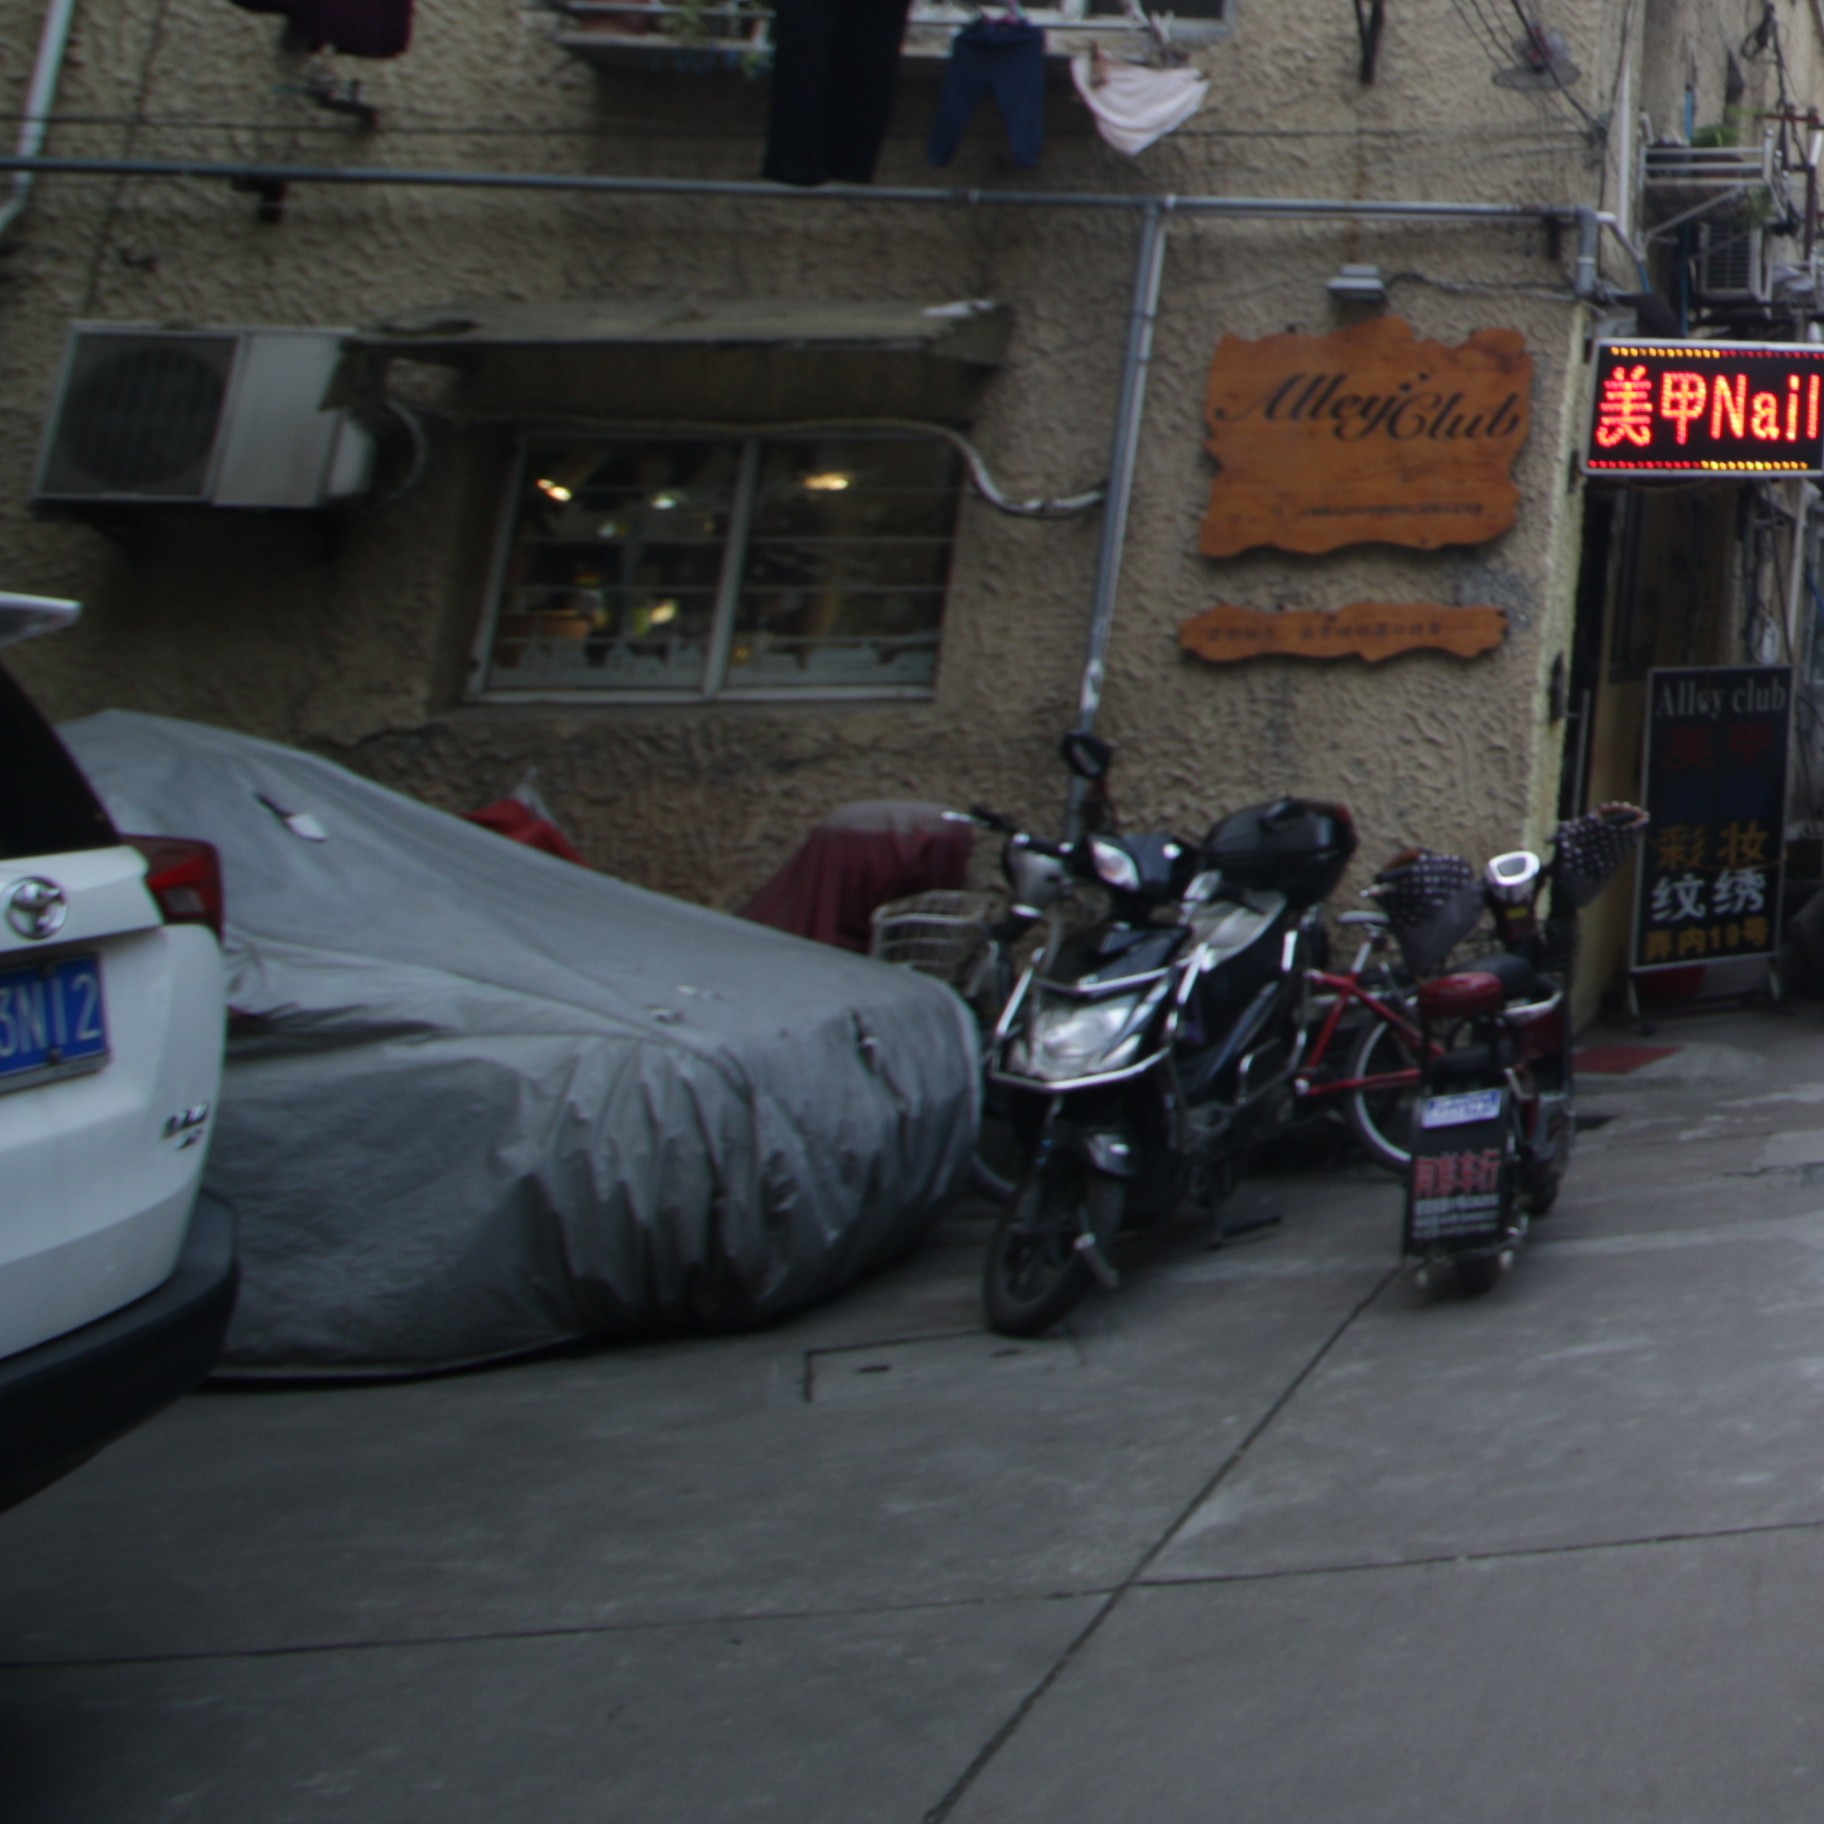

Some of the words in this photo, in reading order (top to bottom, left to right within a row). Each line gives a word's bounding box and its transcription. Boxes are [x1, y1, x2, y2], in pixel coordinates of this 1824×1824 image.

[1655, 679, 1724, 719] Alley
[1731, 676, 1787, 714] club
[1663, 723, 1773, 769] 美甲
[1656, 820, 1770, 872] 彩妆
[1650, 868, 1767, 923] 纹绣
